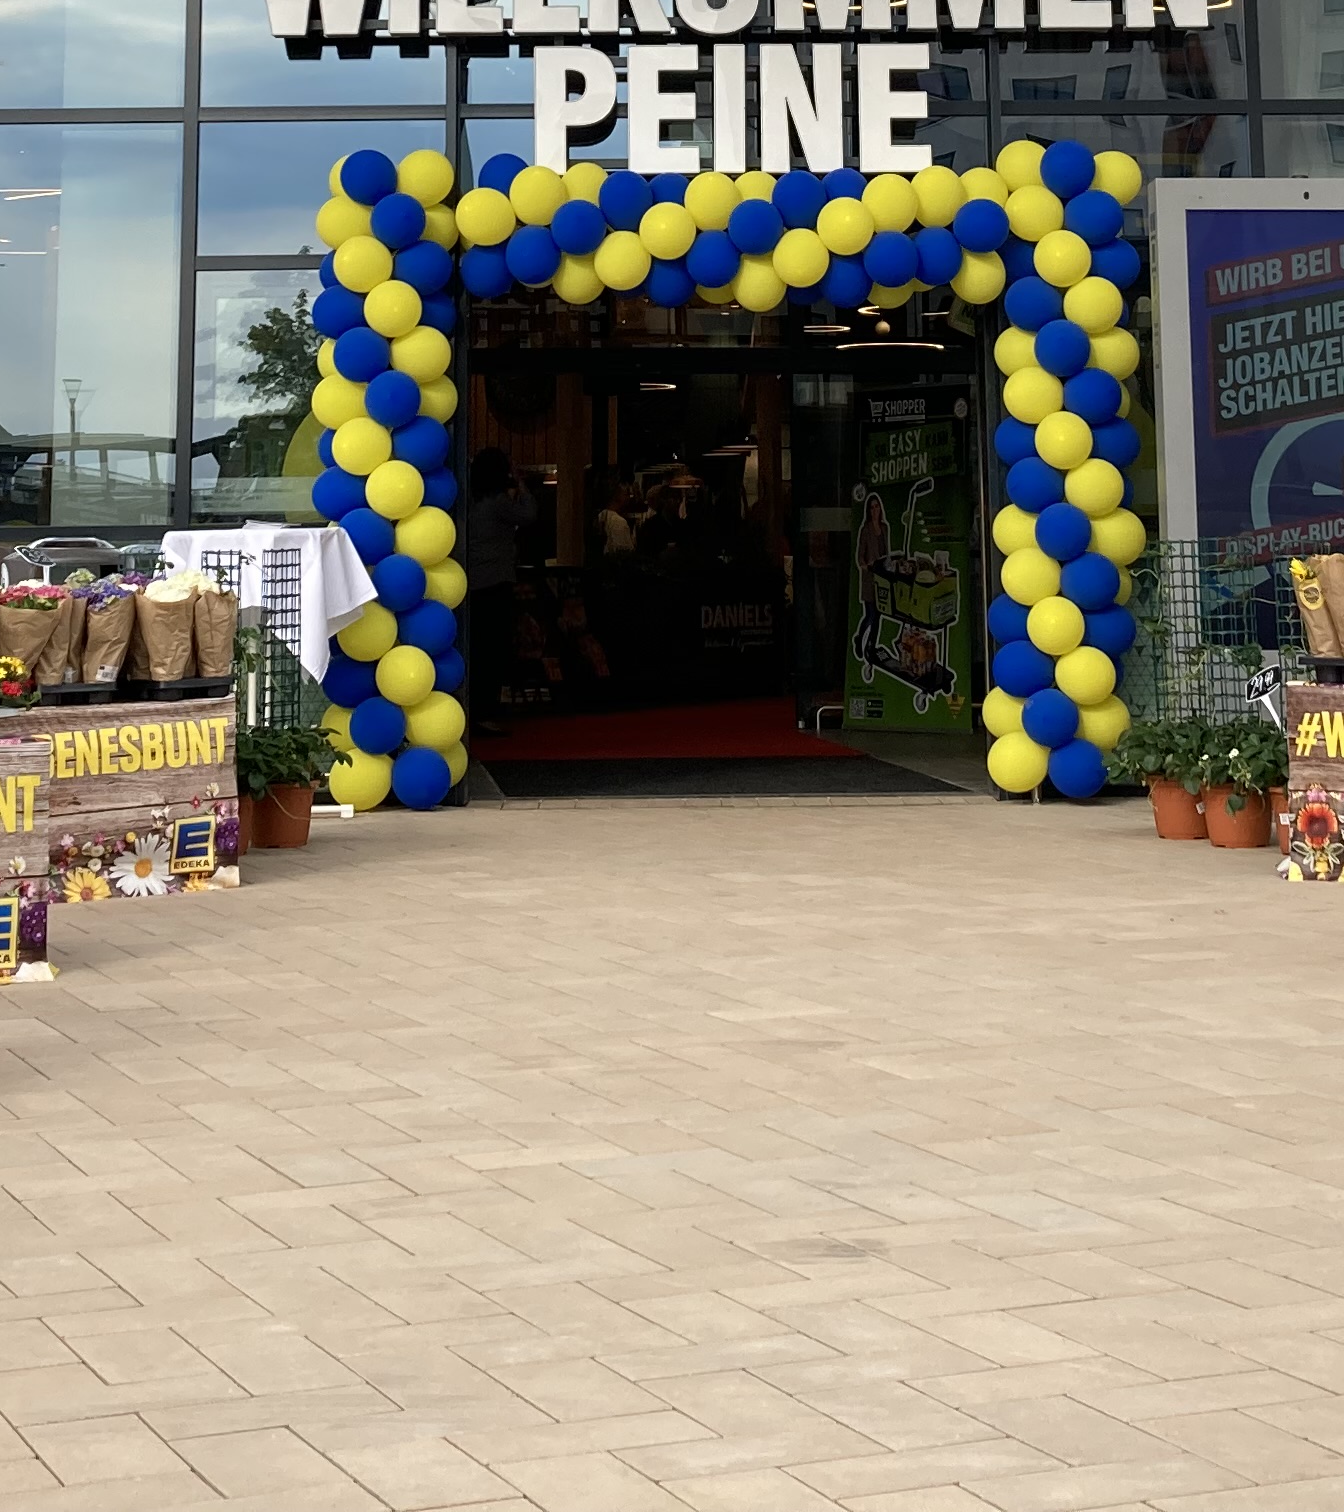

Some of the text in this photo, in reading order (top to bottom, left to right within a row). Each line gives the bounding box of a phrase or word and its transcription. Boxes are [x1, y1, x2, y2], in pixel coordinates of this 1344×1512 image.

[533, 42, 934, 174] PEINE
[1215, 255, 1284, 296] WIRB
[1291, 245, 1332, 281] BEI
[1217, 310, 1297, 353] JETZT
[884, 398, 926, 416] SHOPPER
[889, 429, 922, 456] EASY
[871, 452, 928, 483] SHOPPEN
[50, 717, 229, 779] ENESBUNT
[173, 821, 211, 859] E
[173, 859, 210, 869] EDEKA
